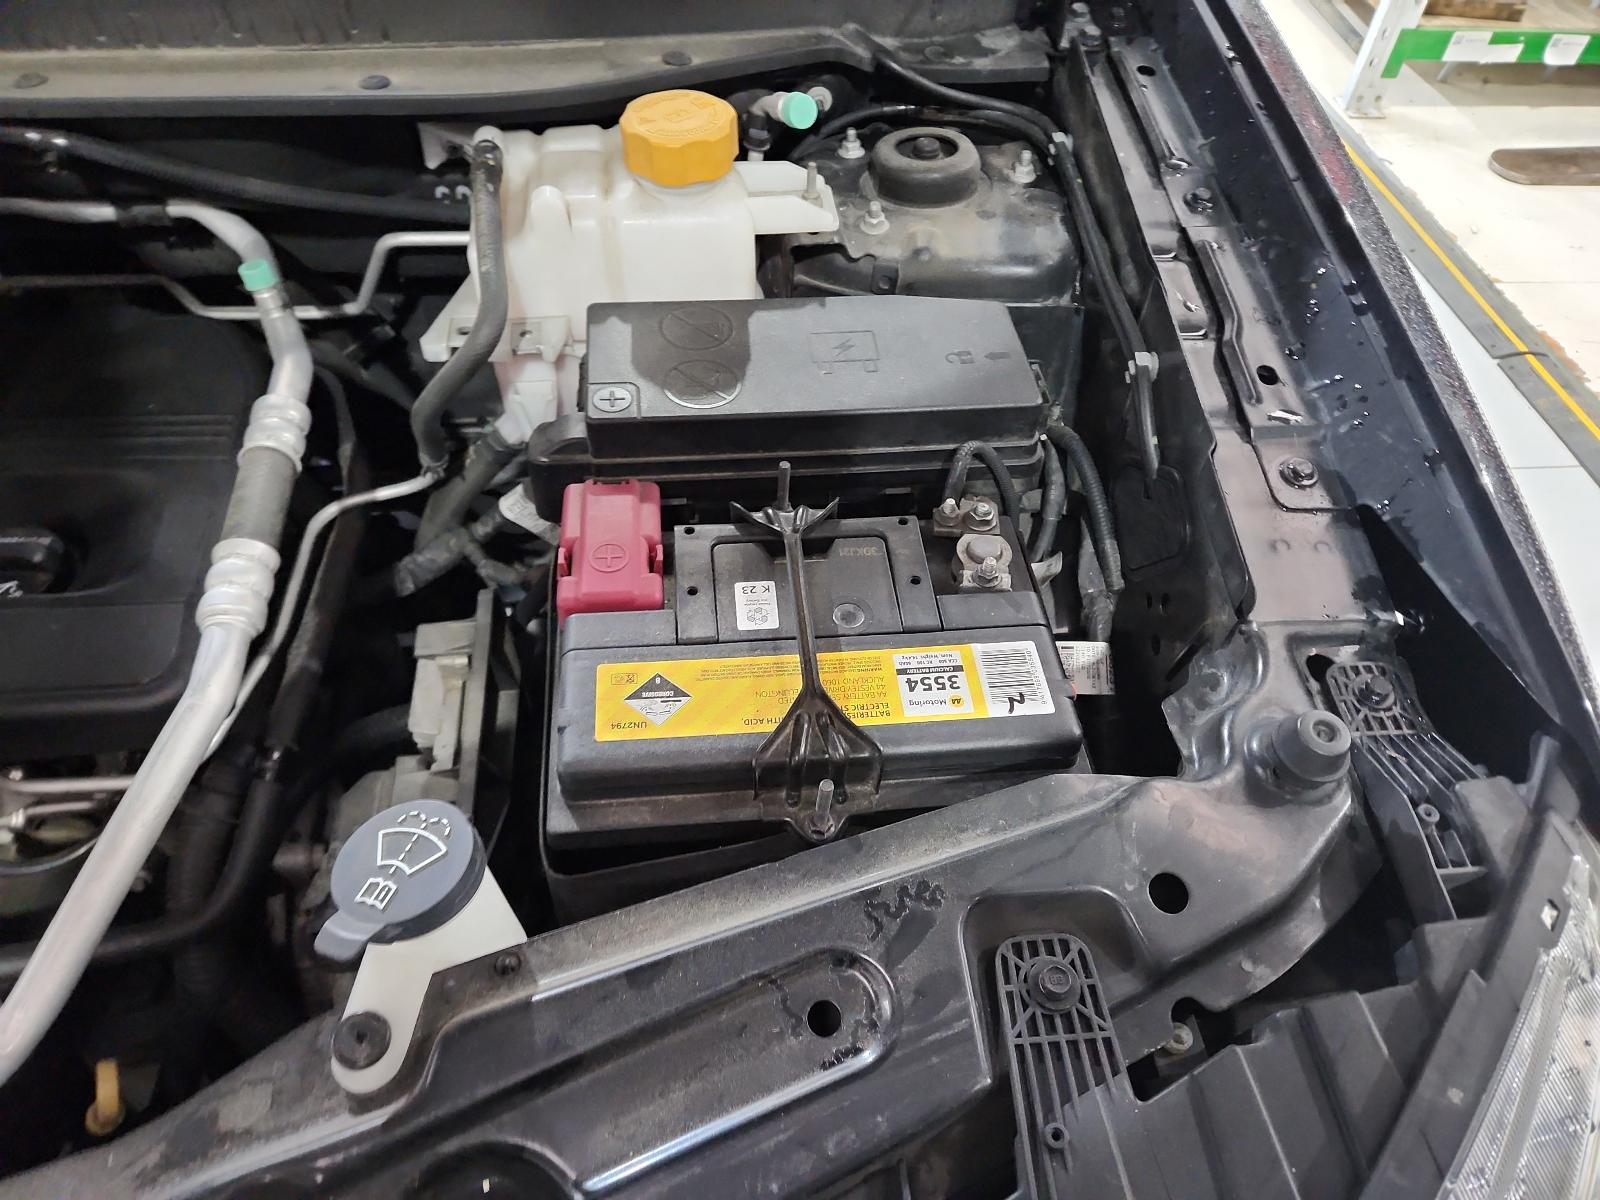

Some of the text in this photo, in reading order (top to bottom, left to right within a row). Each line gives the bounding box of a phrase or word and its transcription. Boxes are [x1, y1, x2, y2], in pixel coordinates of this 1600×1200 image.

[742, 585, 770, 594] K 23
[843, 676, 884, 685] AUCKLAND
[906, 675, 961, 692] 3554
[846, 684, 874, 692] VESTEY
[755, 689, 799, 698] ELLINGTON
[843, 691, 875, 700] BATTERY
[851, 702, 889, 711] ELECTRIC
[909, 698, 947, 707] Motoring
[611, 721, 647, 730] UN2794
[742, 717, 764, 725] ACID,
